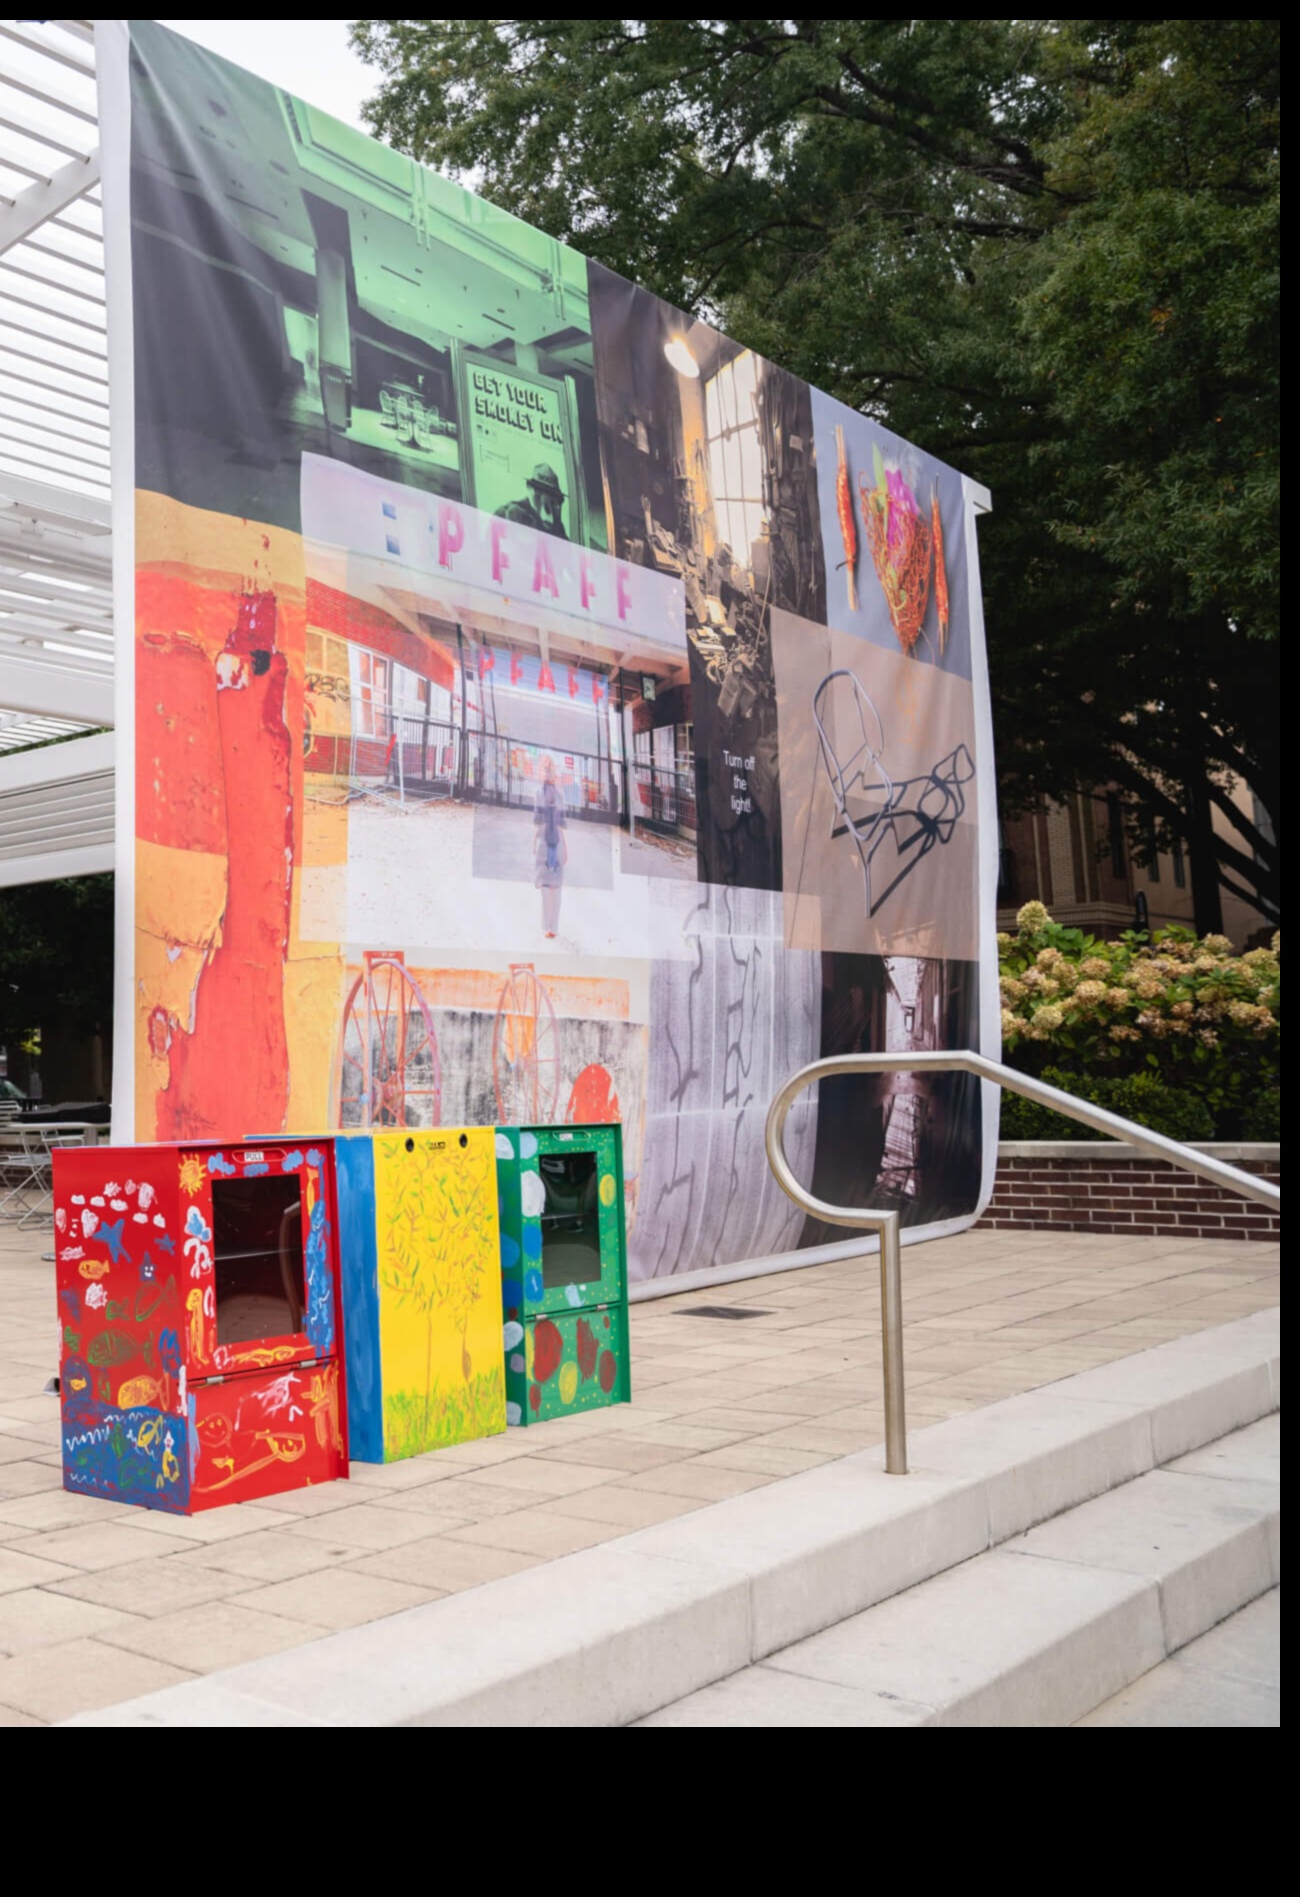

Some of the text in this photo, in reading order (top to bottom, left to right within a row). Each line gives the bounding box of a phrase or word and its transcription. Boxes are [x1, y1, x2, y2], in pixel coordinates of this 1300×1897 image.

[505, 382, 547, 414] YOUR
[475, 395, 535, 433] SMOKEY
[540, 420, 564, 445] ON
[438, 502, 633, 621] PFAFF
[477, 643, 606, 705] PFAFF
[723, 750, 756, 771] Turn off
[733, 774, 747, 790] the
